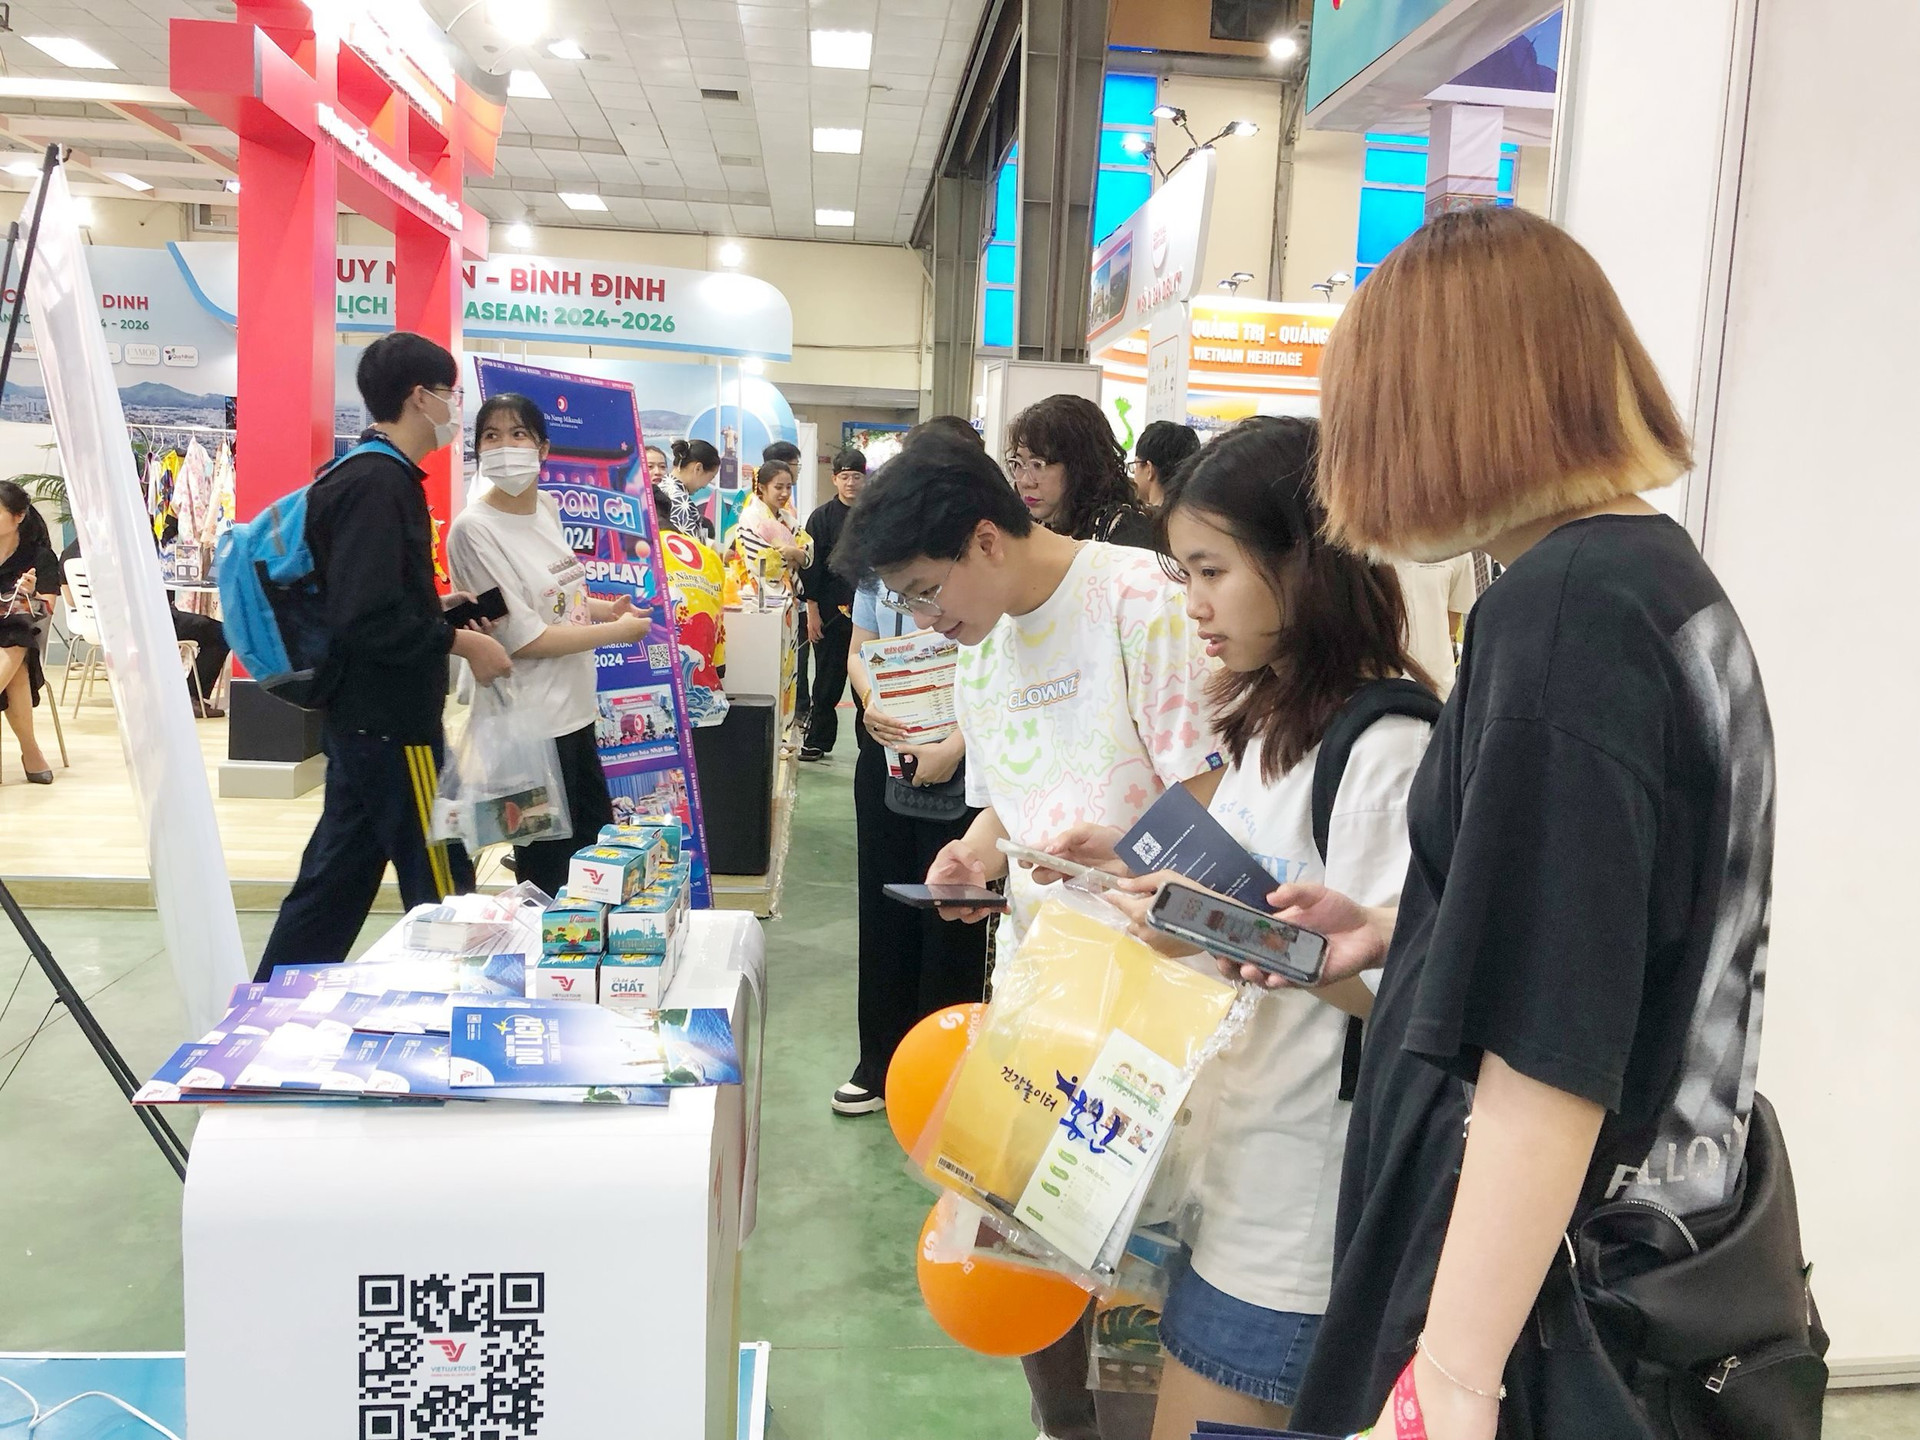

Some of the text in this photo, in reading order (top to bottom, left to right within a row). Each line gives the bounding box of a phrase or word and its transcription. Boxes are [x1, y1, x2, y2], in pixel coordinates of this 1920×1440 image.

[510, 263, 582, 296] BÌNH
[591, 273, 666, 306] ĐỊNH
[102, 294, 149, 311] DINH
[337, 294, 676, 333] LỊCH ASEAN: 2024-2026
[120, 319, 150, 331] 2026
[1242, 323, 1266, 346] TRỊ
[1193, 346, 1303, 367] VIETNAM HERITAGE
[1008, 673, 1079, 709] CLOWNZ
[611, 978, 645, 993] CHẤT
[515, 1048, 545, 1065] DU
